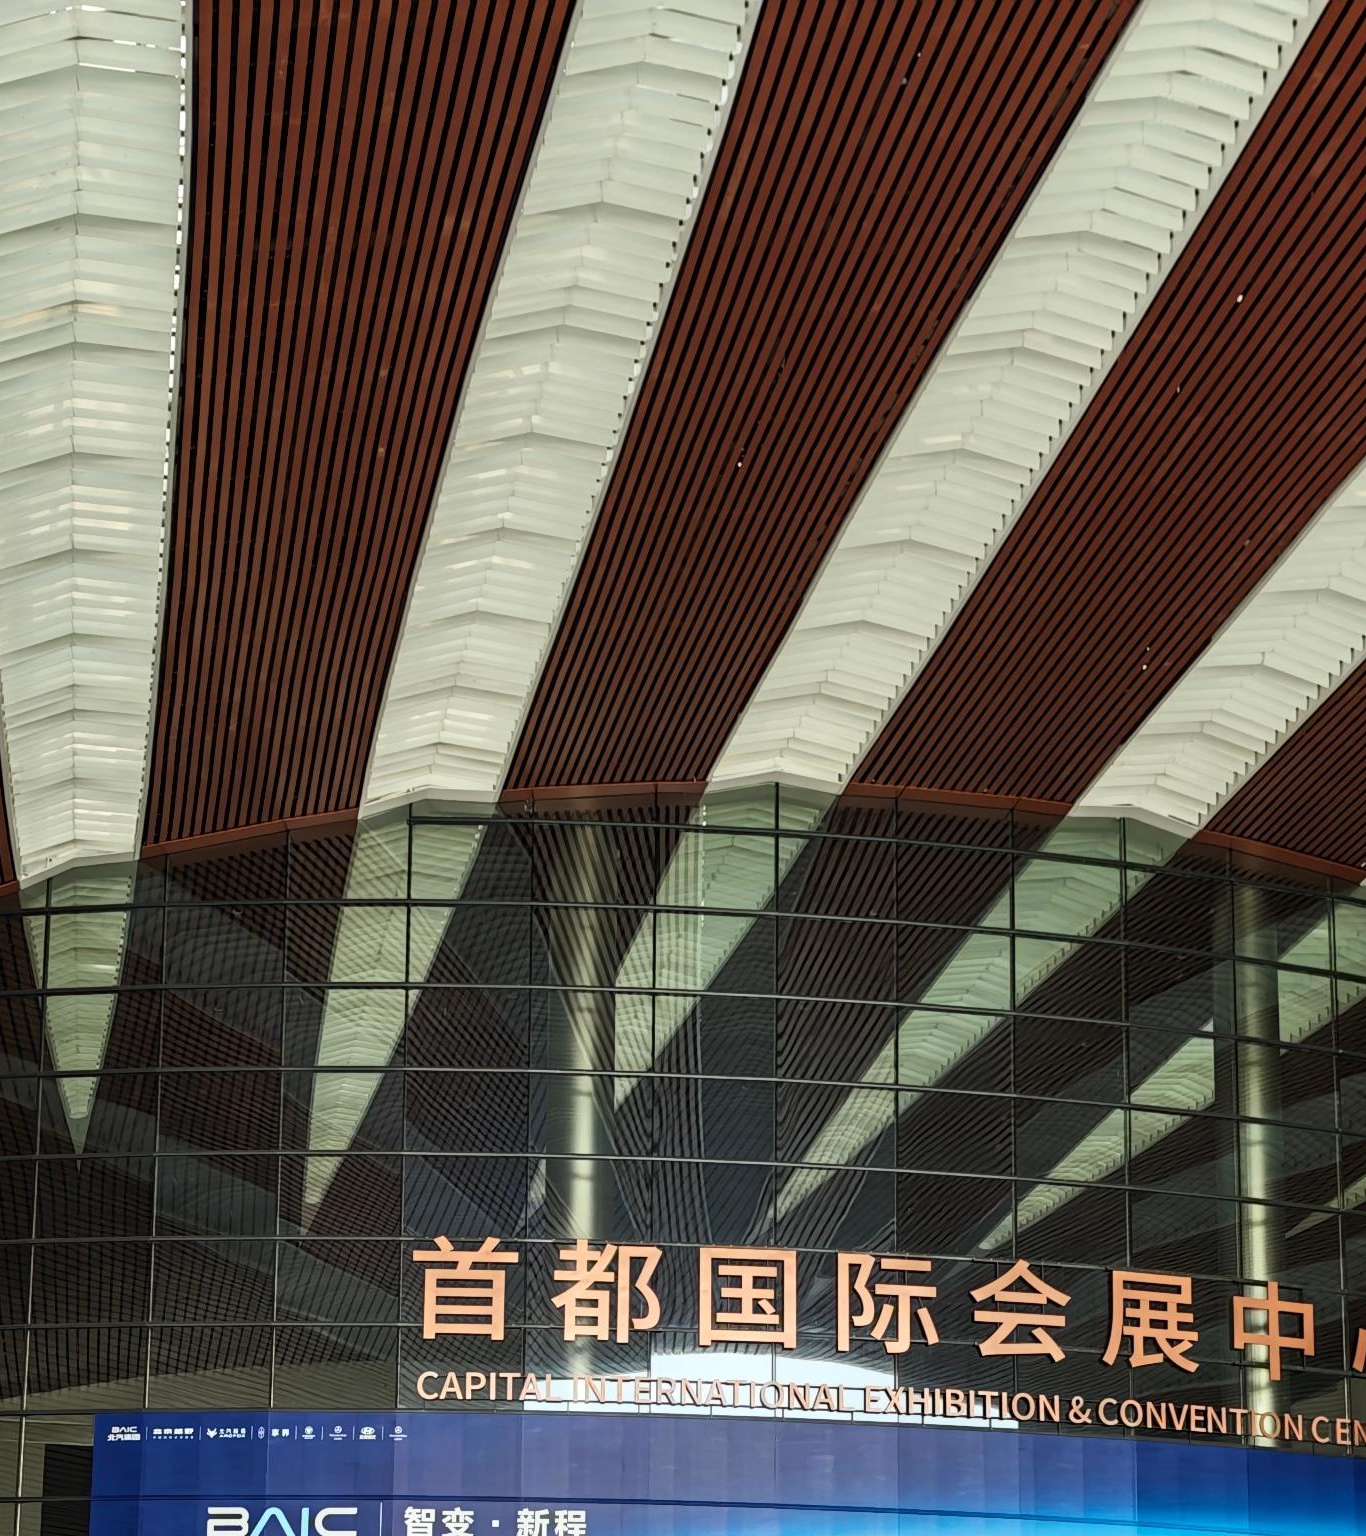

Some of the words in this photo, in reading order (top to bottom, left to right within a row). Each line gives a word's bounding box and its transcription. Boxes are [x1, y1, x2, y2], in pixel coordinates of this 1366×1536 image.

[416, 1370, 562, 1402] CAPITAL
[573, 1374, 855, 1413] INTERNATIONAL
[864, 1385, 1061, 1422] EXHIBITION
[1068, 1395, 1092, 1425] &
[1098, 1397, 1304, 1442] CONVENTION
